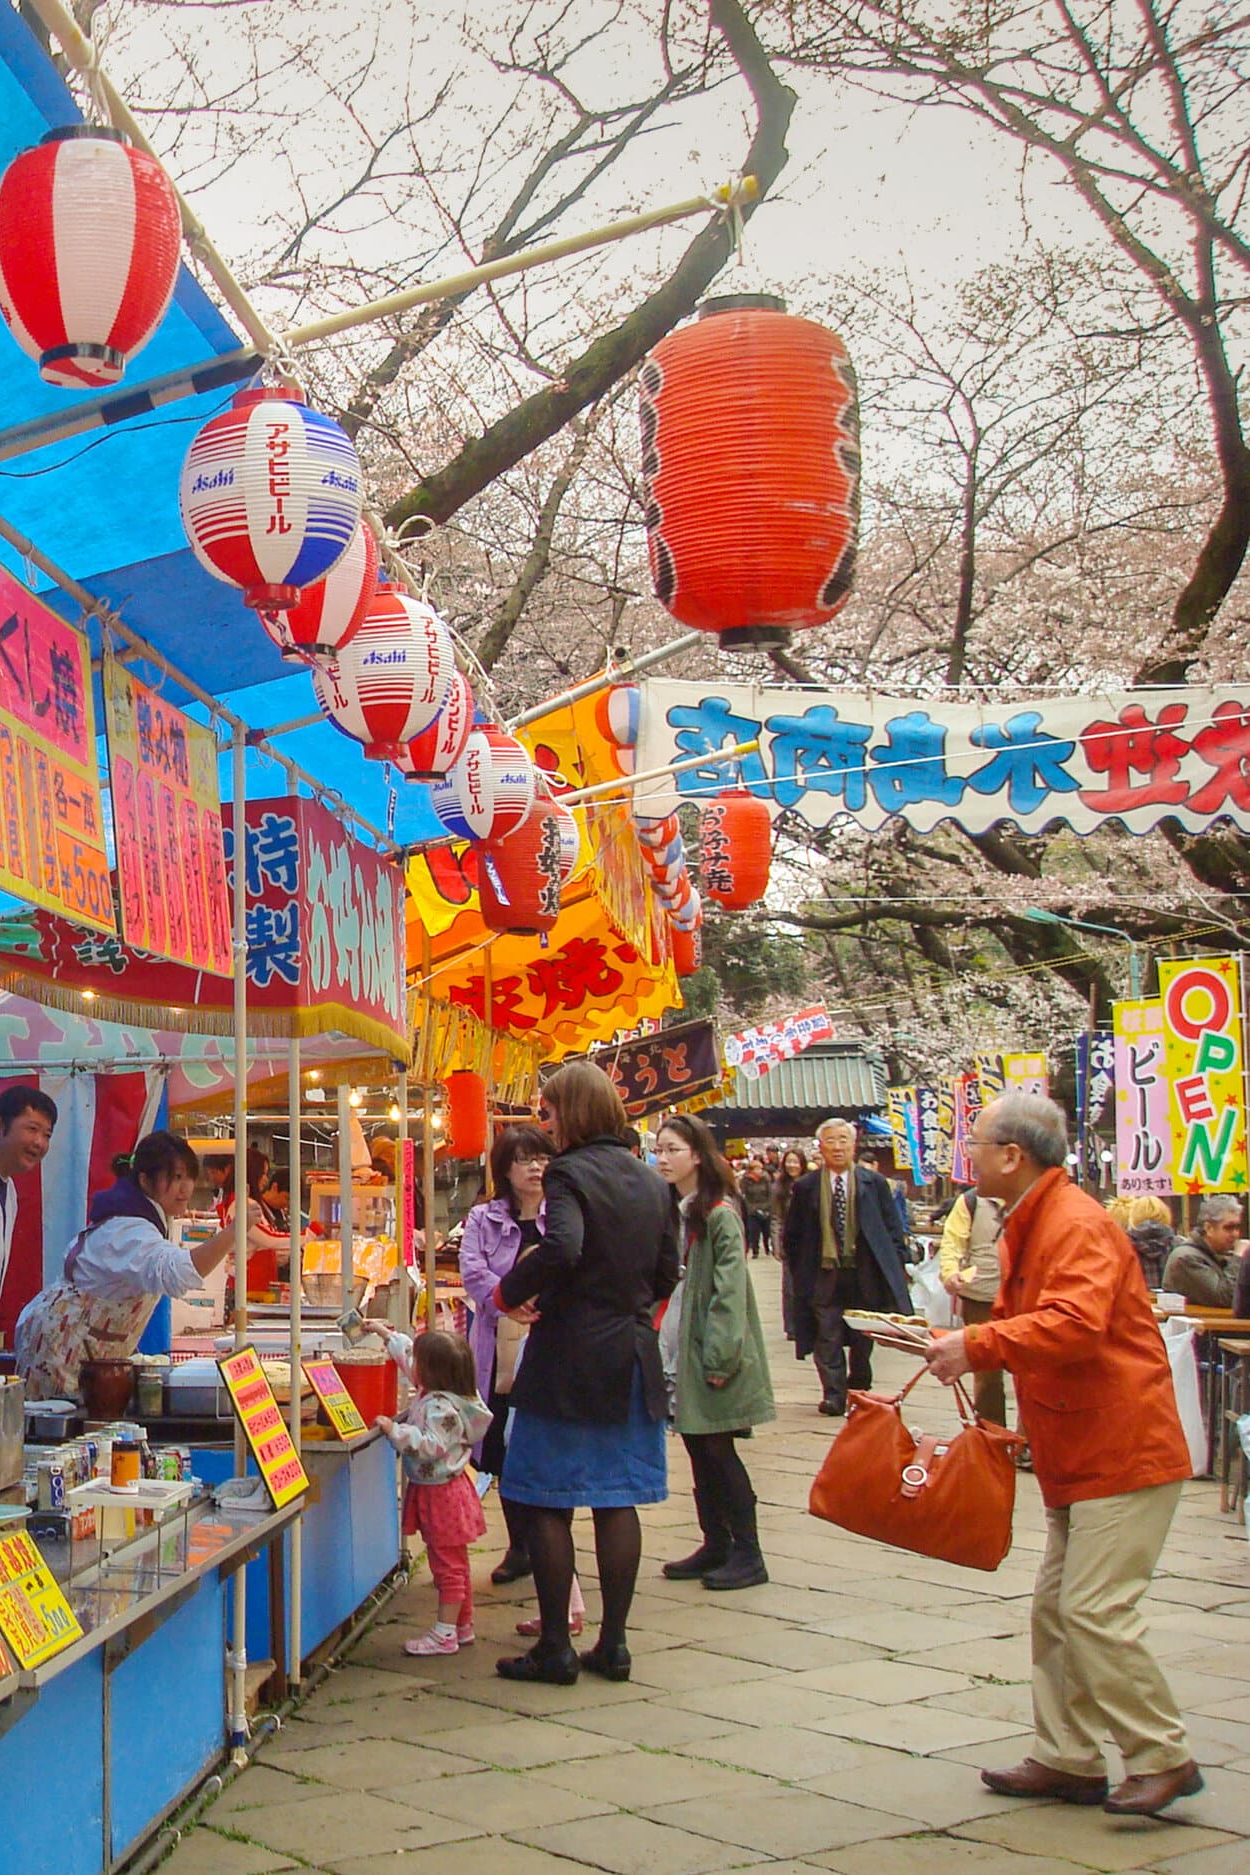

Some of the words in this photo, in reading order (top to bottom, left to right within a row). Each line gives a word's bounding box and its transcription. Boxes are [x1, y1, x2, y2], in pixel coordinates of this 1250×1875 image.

[191, 468, 235, 495] Asahi
[265, 422, 293, 535] アサヒビール
[328, 657, 349, 710] ビール
[362, 648, 408, 666] Asahi
[419, 615, 442, 704] アサヒビール
[465, 749, 485, 815] アサヒビール
[225, 814, 301, 988] 特製
[1127, 1040, 1164, 1173] ビール
[1166, 967, 1239, 1184] OPEN
[1120, 1176, 1173, 1192] あります!
